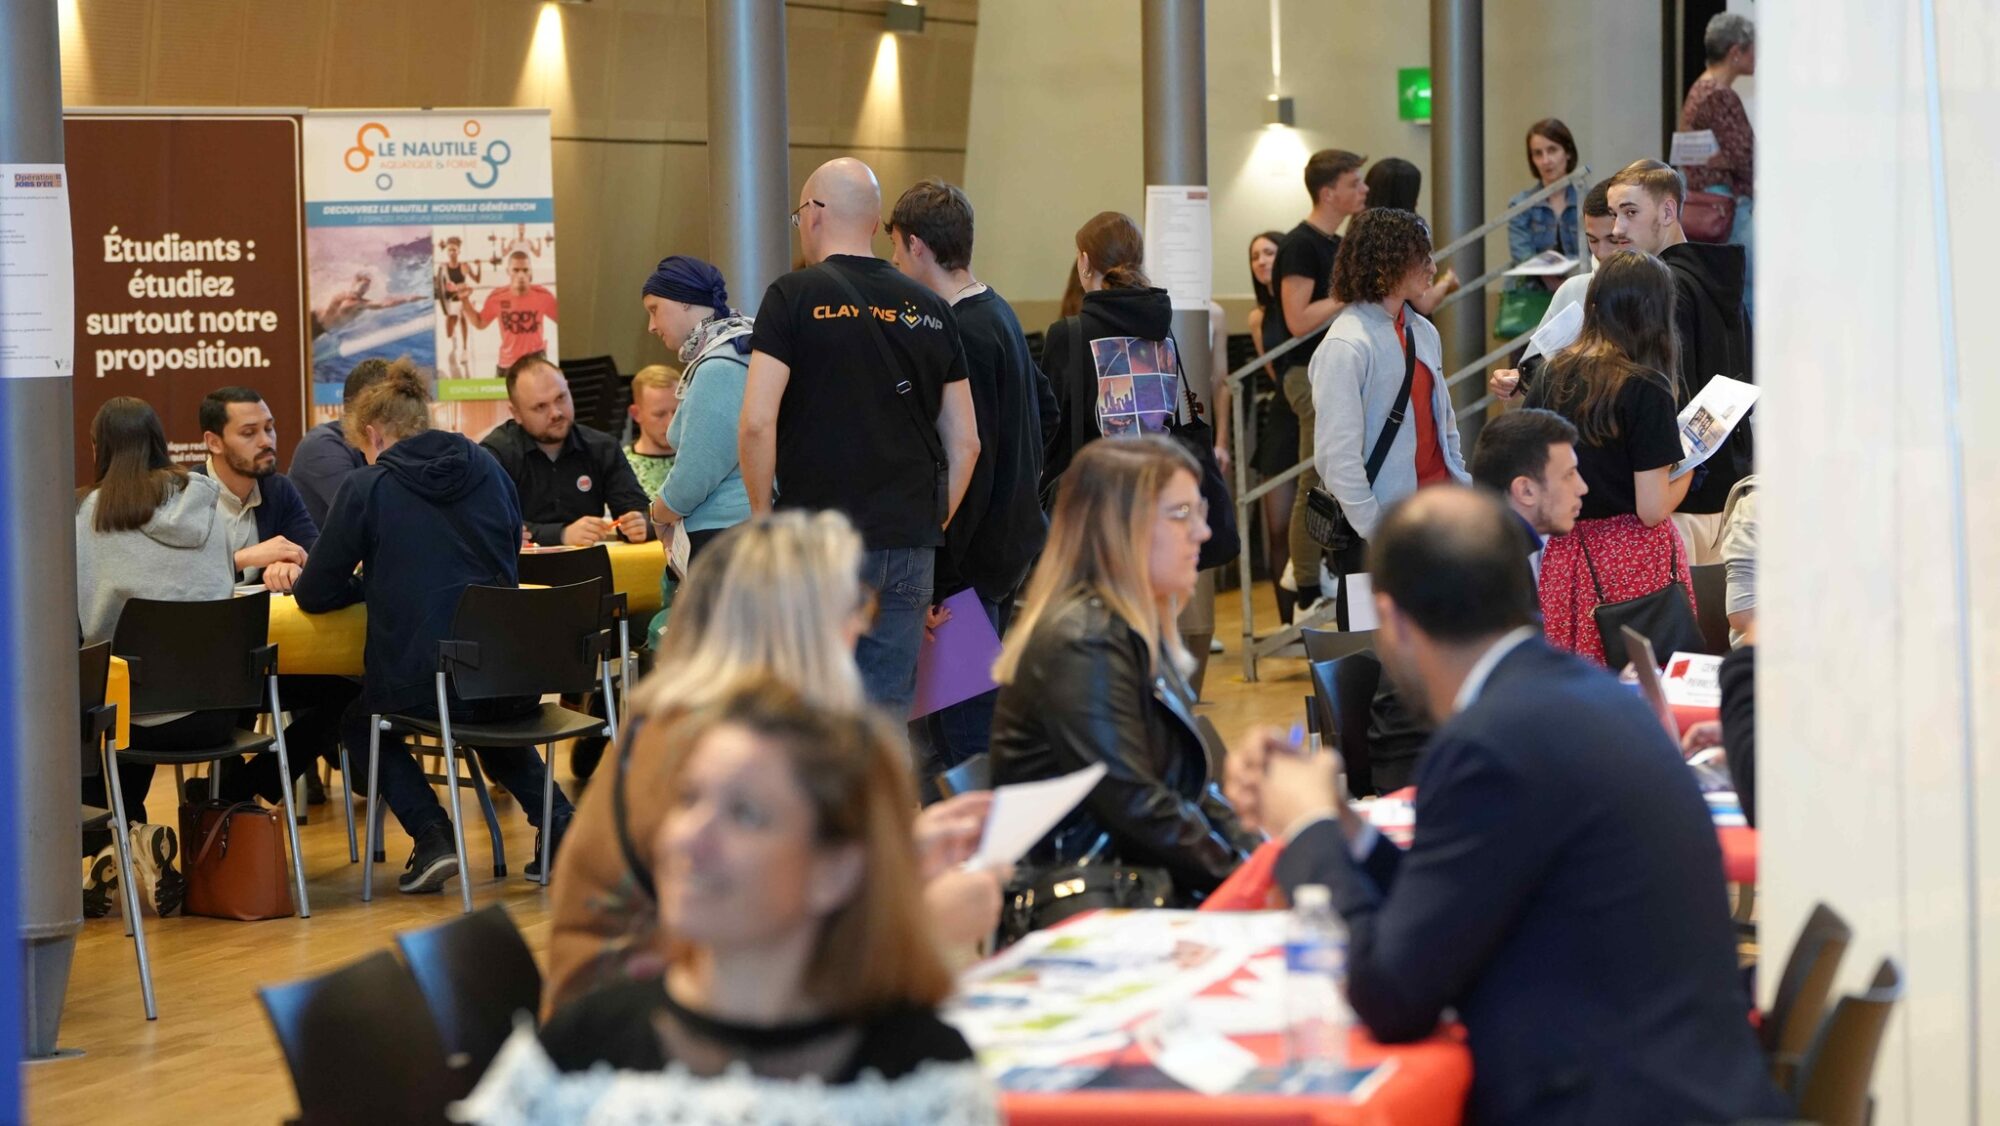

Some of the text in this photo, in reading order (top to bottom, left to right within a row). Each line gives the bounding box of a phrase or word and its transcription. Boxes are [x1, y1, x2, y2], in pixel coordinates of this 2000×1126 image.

[378, 141, 478, 157] LE NAUTILE
[446, 159, 478, 169] FORME
[380, 204, 390, 214] LE
[391, 203, 428, 213] NAUTILE
[432, 202, 477, 213] NOUVELLE
[479, 201, 537, 212] GÉNÉRATION
[103, 225, 241, 263] Étudiants
[127, 268, 235, 298] étudiez
[86, 308, 278, 336] surtout notre
[501, 310, 538, 323] BODY
[96, 339, 271, 378] proposition.
